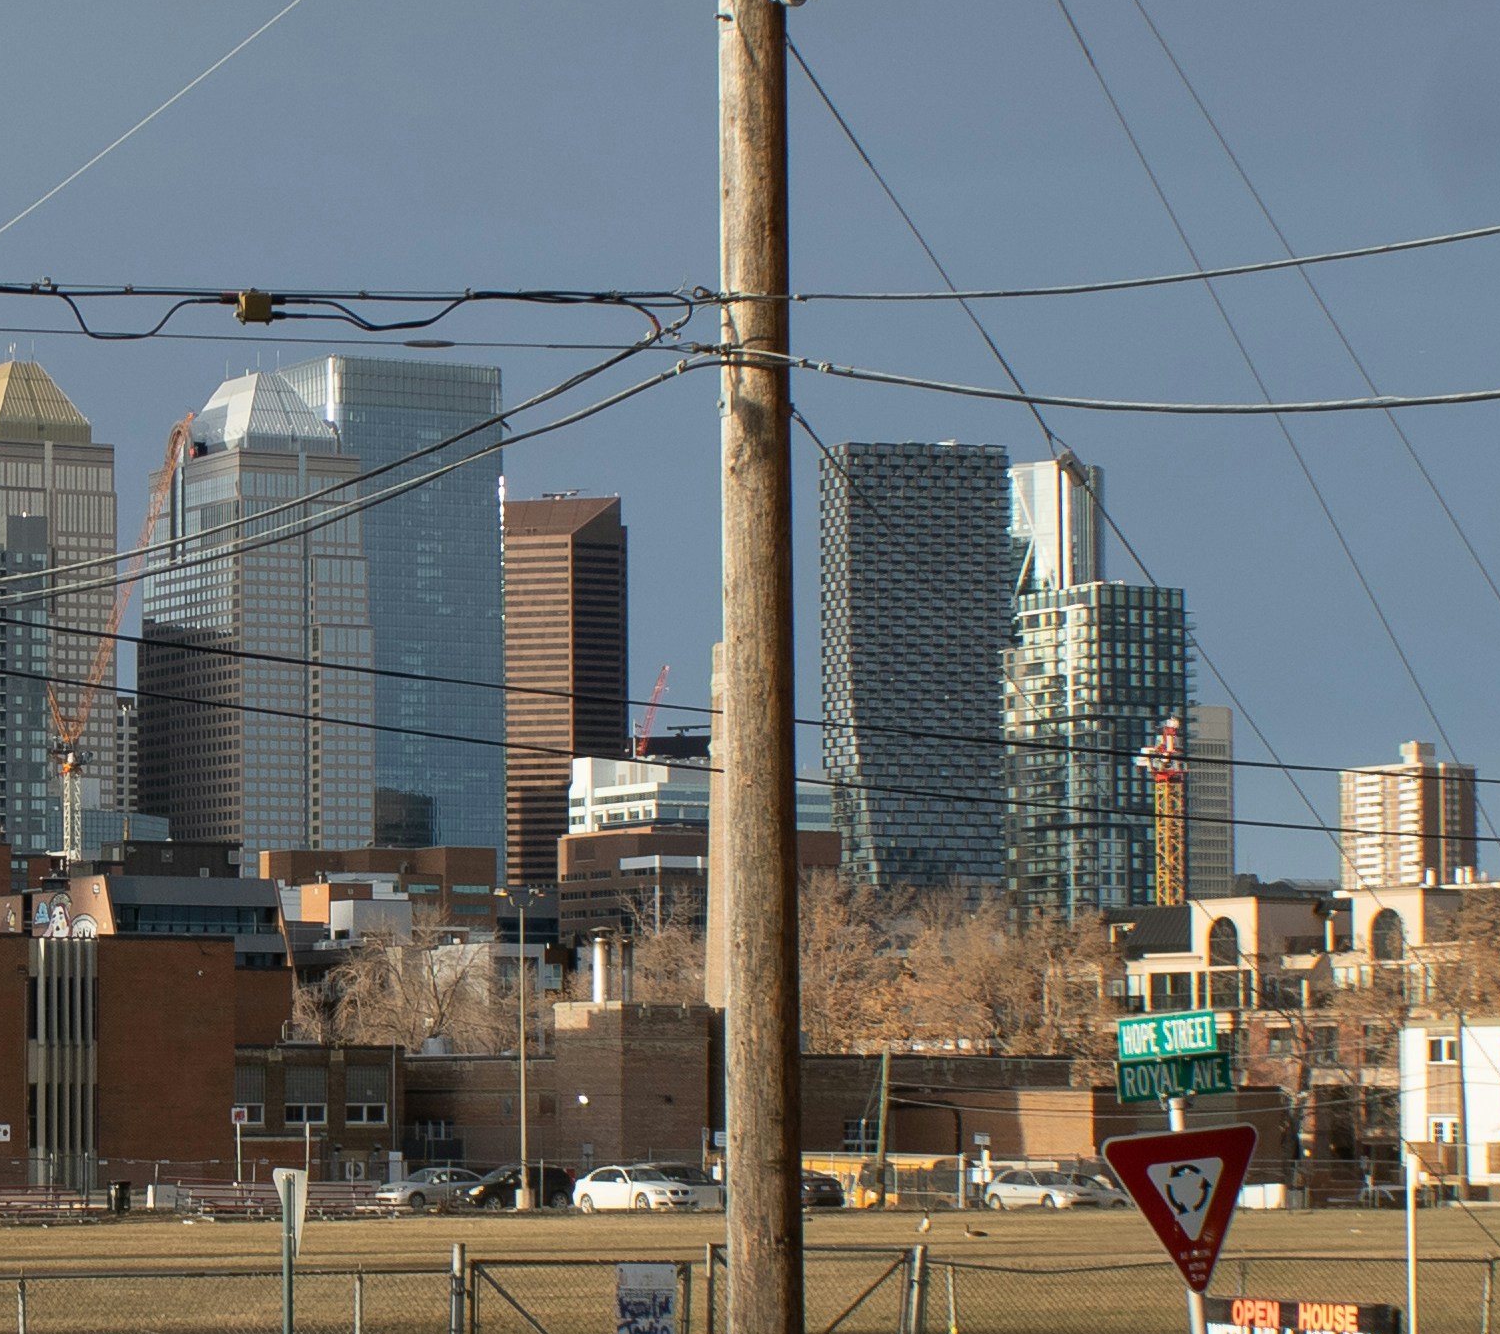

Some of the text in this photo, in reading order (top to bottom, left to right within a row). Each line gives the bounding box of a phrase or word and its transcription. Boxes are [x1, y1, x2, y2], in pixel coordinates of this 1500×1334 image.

[1122, 1016, 1212, 1055] HOPE STREET
[1123, 1058, 1225, 1097] ROYAL AVE
[1233, 1299, 1358, 1331] OPEN HOUSE
